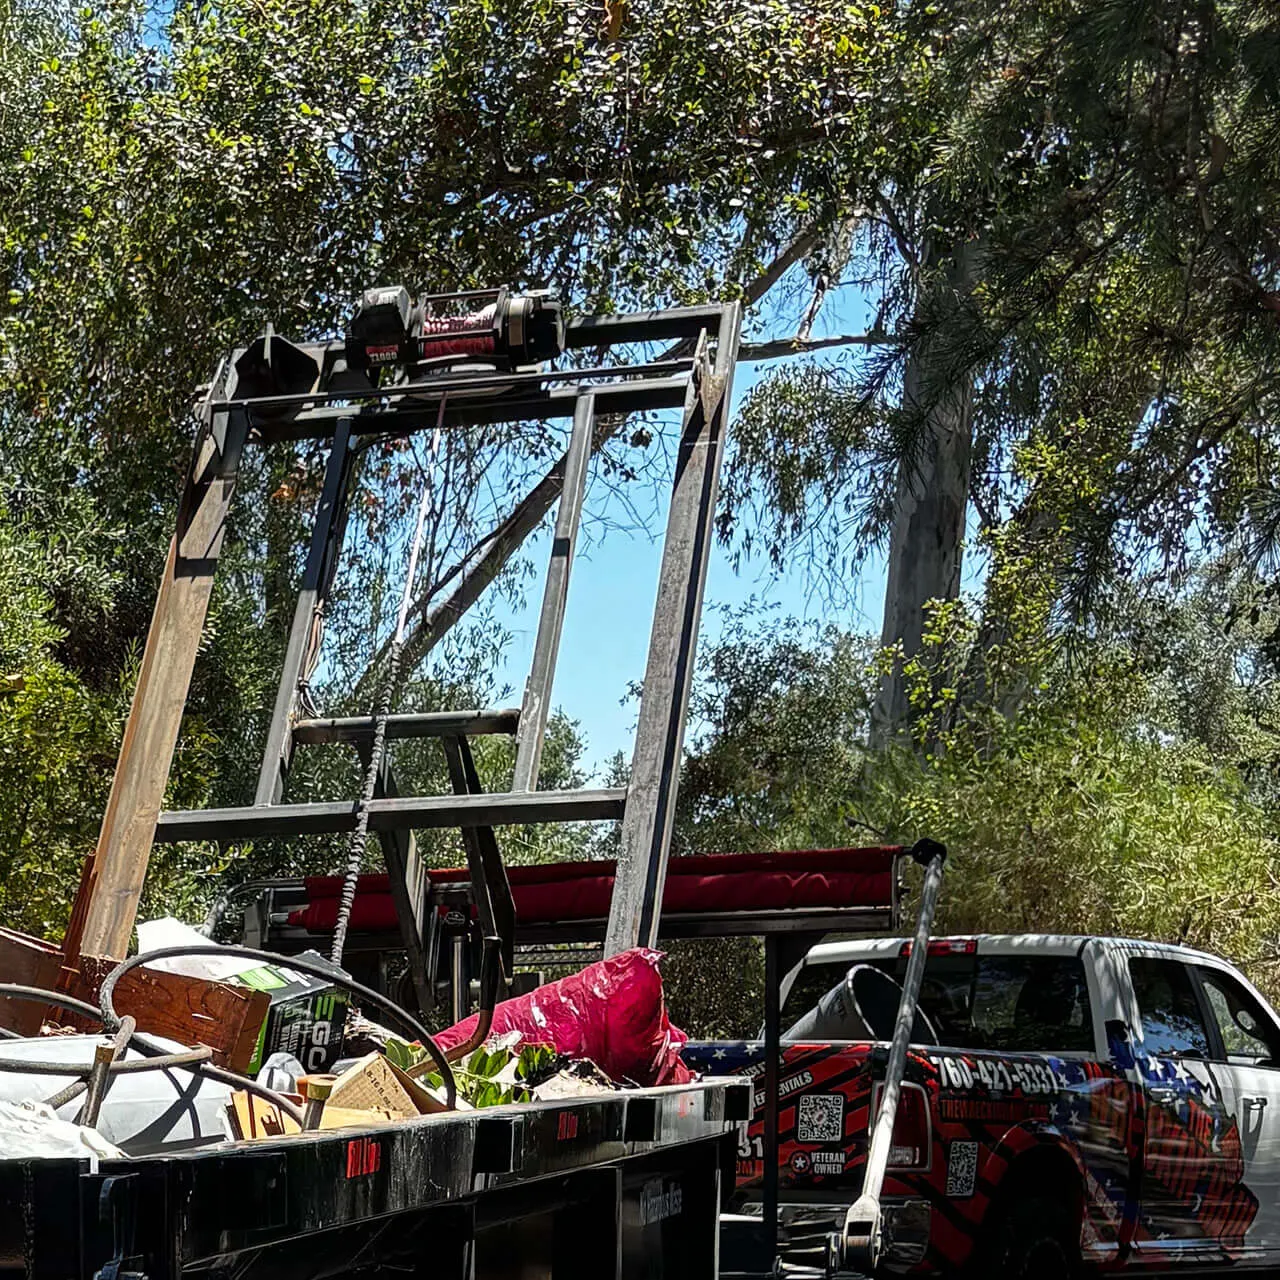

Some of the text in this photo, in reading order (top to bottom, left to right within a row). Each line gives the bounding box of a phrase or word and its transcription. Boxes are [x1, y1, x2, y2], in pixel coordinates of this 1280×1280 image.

[930, 1055, 1058, 1094] 760-421-5331
[811, 1152, 845, 1163] VETERAN
[814, 1163, 842, 1174] OWNED
